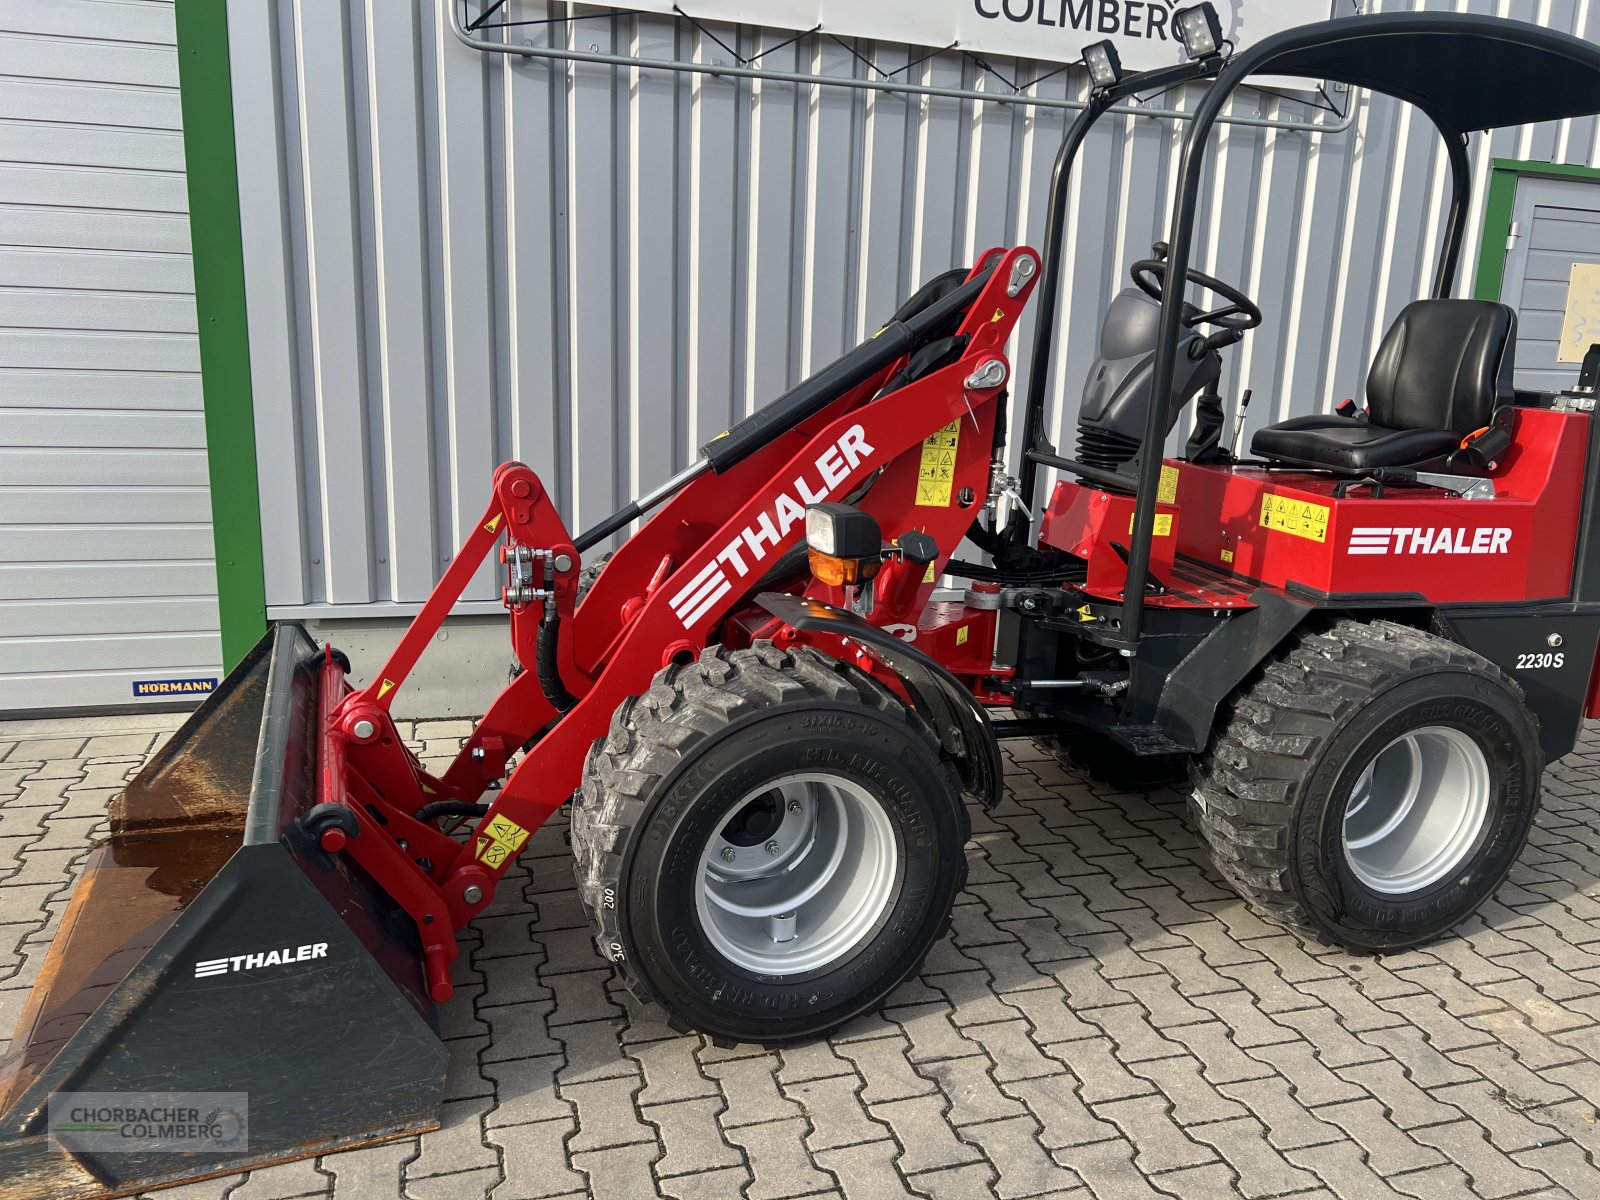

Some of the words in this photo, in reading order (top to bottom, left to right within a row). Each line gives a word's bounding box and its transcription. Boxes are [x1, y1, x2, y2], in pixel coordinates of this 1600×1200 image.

[716, 424, 875, 578] THALER
[1391, 527, 1512, 554] THALER
[1515, 653, 1564, 669] 2230S
[138, 681, 212, 693] HÖRMANN
[661, 774, 697, 819] BKT
[603, 888, 615, 909] 200
[229, 943, 328, 972] THALER
[610, 943, 625, 962] 3.0
